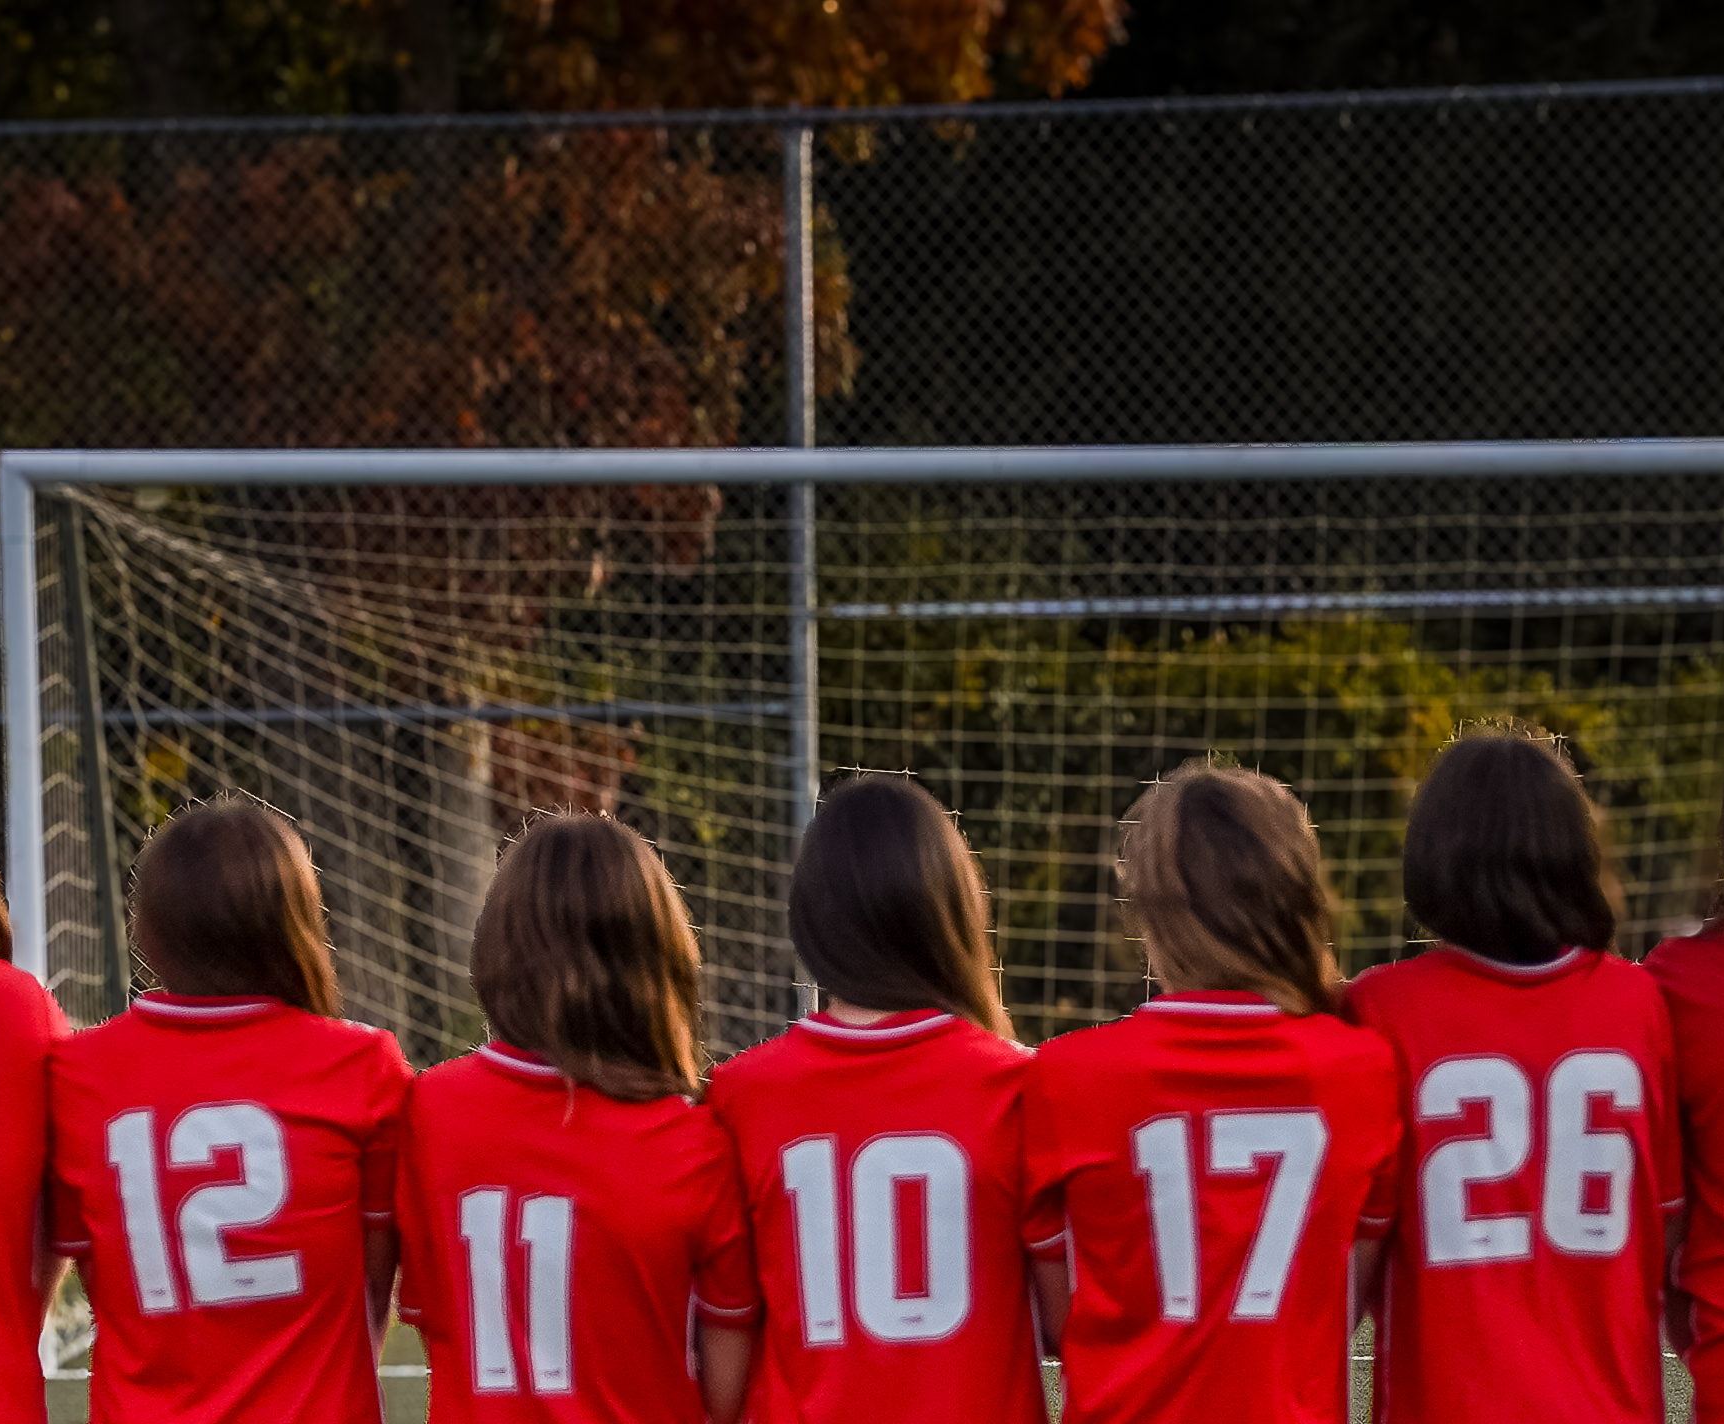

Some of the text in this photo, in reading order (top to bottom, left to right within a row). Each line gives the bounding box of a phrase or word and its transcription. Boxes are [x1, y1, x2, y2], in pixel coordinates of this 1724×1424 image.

[104, 1101, 303, 1314] 12
[780, 1132, 972, 1345] 10
[1132, 1109, 1330, 1323] 17
[1417, 1049, 1644, 1266] 26
[458, 1187, 575, 1396] 11
